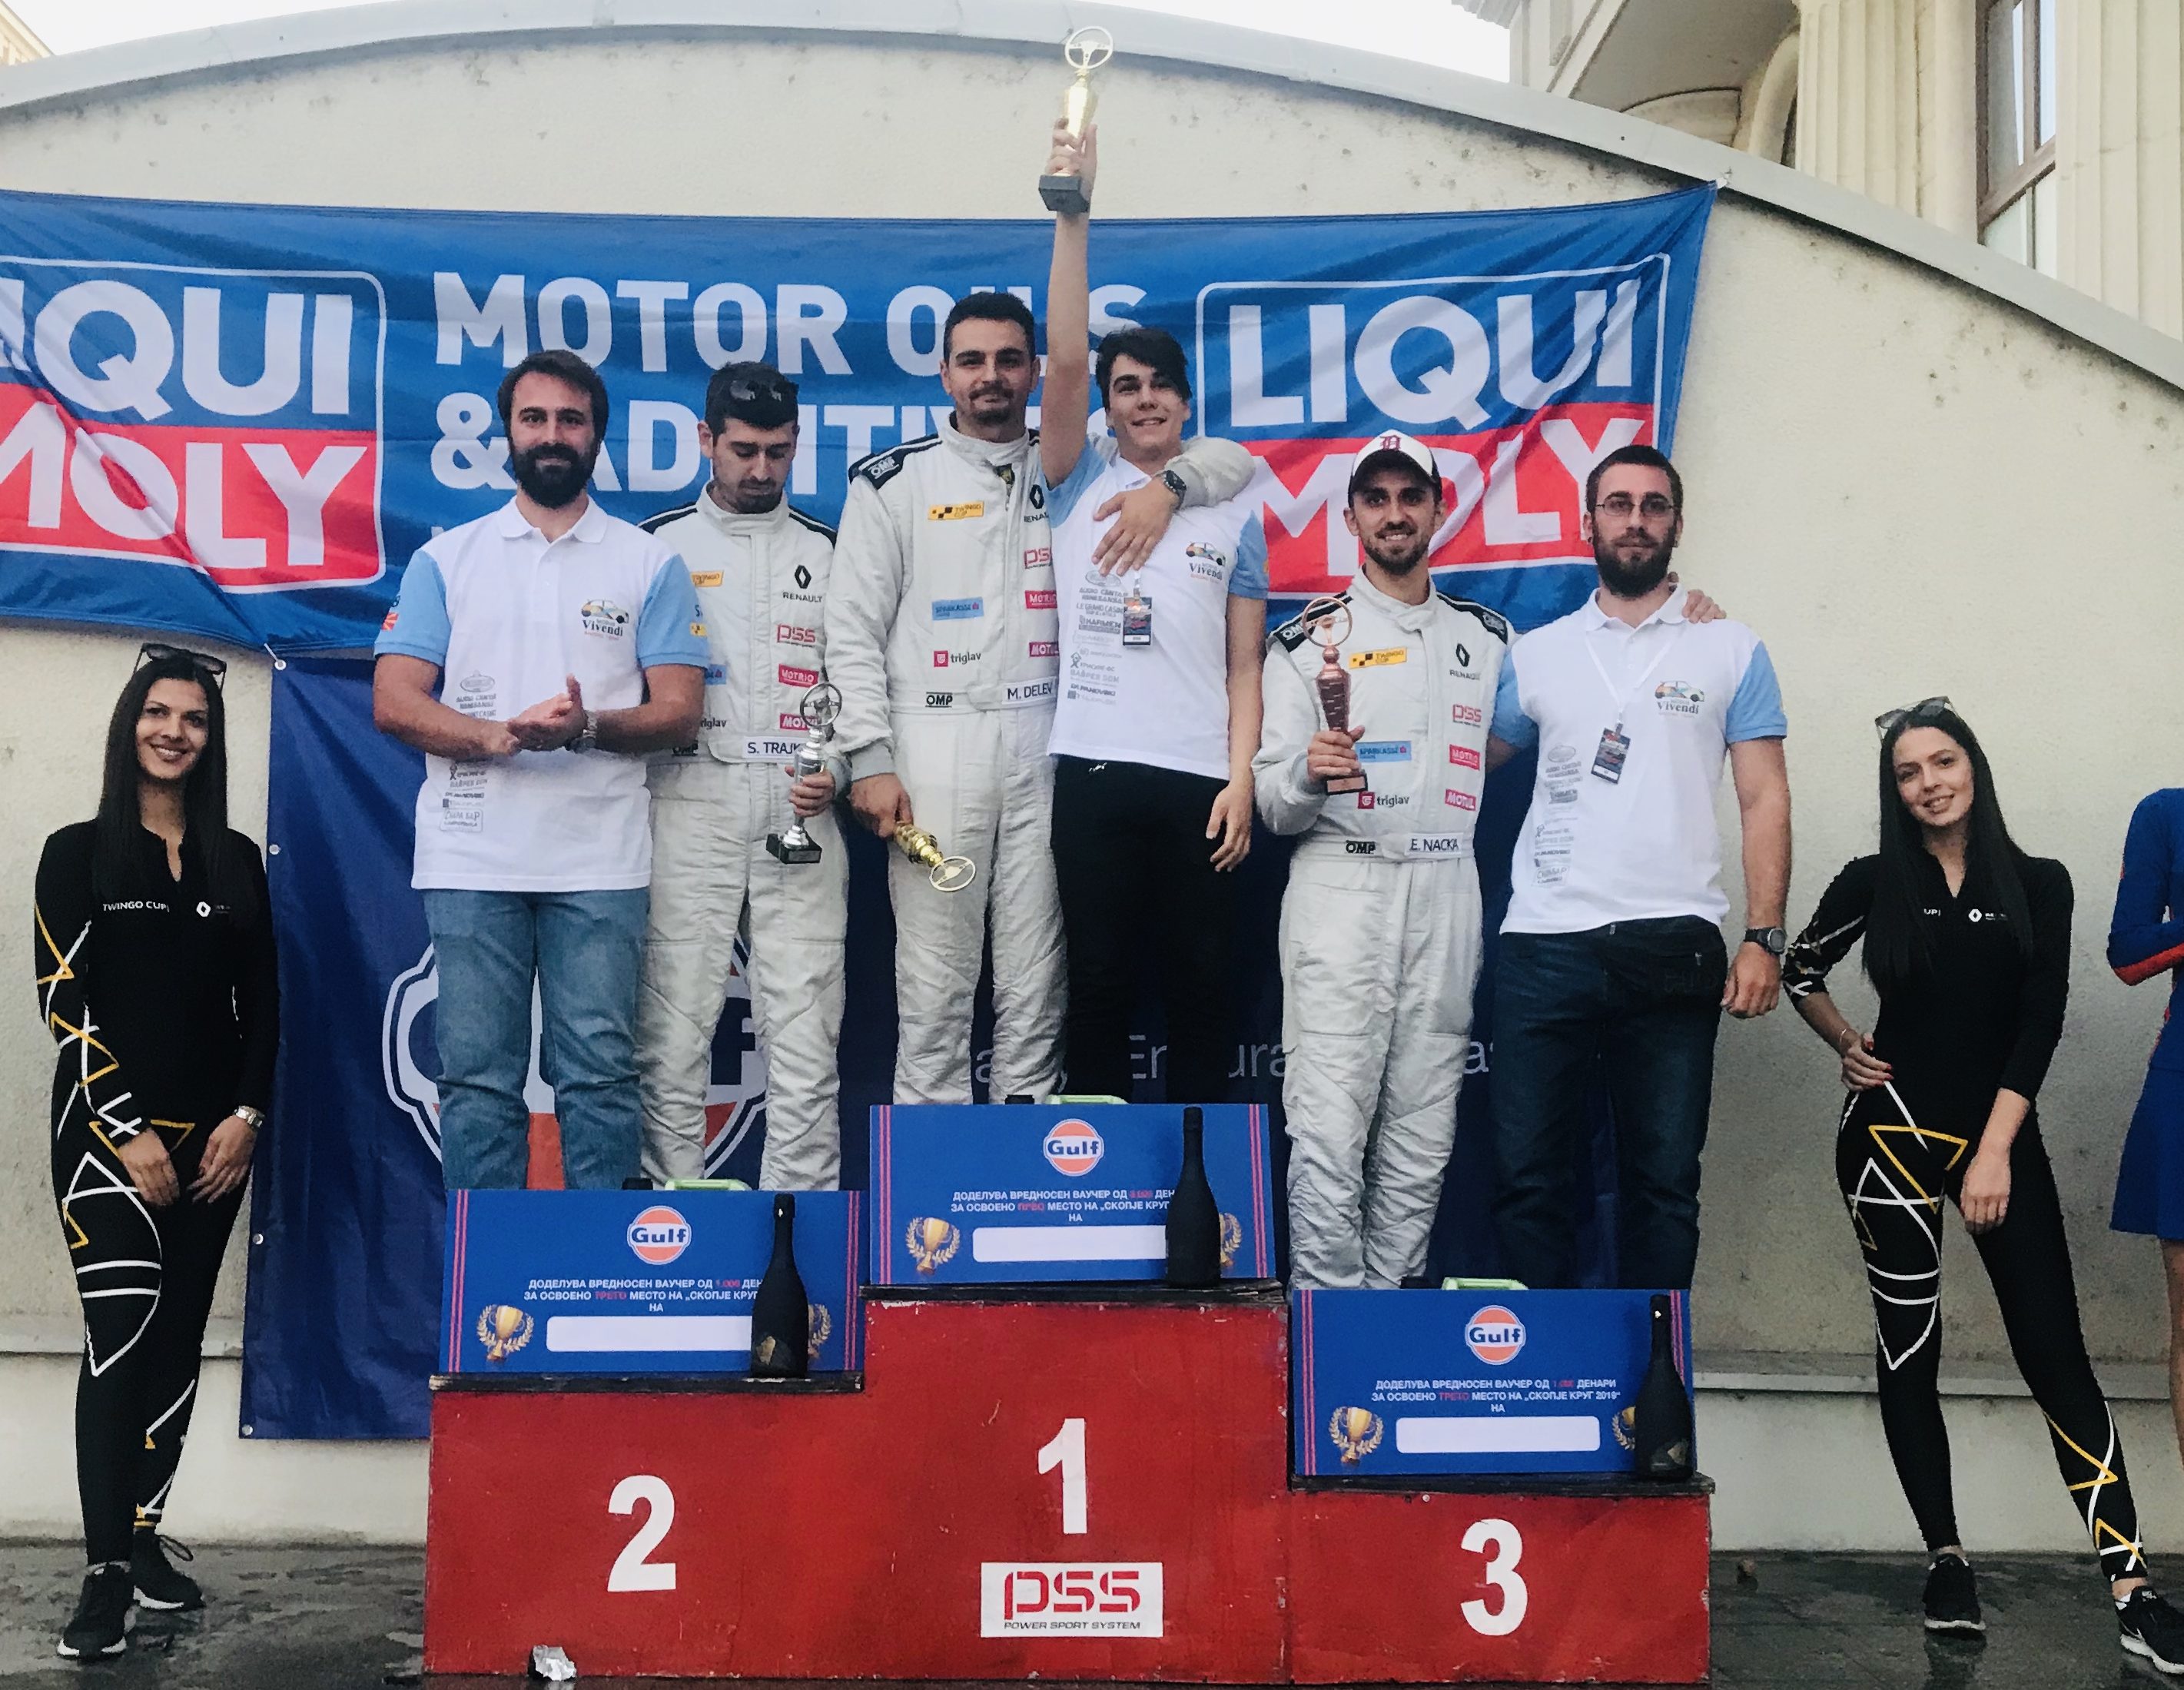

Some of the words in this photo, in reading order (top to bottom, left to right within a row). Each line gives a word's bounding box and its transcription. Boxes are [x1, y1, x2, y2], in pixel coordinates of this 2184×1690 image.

[433, 271, 853, 376] MOTOR
[0, 277, 353, 421] IQUI
[1229, 278, 1641, 430] LIQUI
[782, 591, 823, 603] RENAULT
[582, 619, 623, 636] Vivendi
[777, 623, 816, 643] PSS
[1282, 622, 1304, 638] OM
[951, 651, 982, 665] triglav
[781, 669, 815, 681] MOTRIO
[926, 692, 953, 706] OMP
[1007, 687, 1022, 700] M.
[1452, 704, 1482, 722] PSS
[1657, 701, 1700, 715] Vivendi
[700, 717, 727, 730] riglav
[748, 742, 760, 754] S.
[1376, 794, 1410, 808] triglav
[1346, 842, 1376, 854] OMP
[102, 901, 144, 911] TWINGO
[146, 901, 167, 910] CUP
[1047, 1140, 1100, 1155] Gulf
[952, 1191, 1007, 1201] ДОДЕЛУВА
[1010, 1190, 1070, 1201] ВРЕДНОСЕН
[1073, 1190, 1110, 1200] ВАУЧЕР
[1113, 1190, 1128, 1200] ОД
[951, 1203, 964, 1212] ЗА
[966, 1203, 1016, 1212] ОСВОЕНО
[1047, 1202, 1082, 1211] МЕСТО
[1084, 1201, 1098, 1210] НА
[1068, 1214, 1083, 1222] НА
[631, 1227, 687, 1243] Gulf
[528, 1280, 586, 1290] ДОДЕЛУВА
[589, 1279, 652, 1290] ВРЕДНОСЕН
[655, 1279, 695, 1288] ВАУЧЕР
[698, 1279, 713, 1290] ОД
[523, 1291, 538, 1300] ЗА
[540, 1291, 591, 1300] ОСВОЕНО
[629, 1291, 665, 1300] МЕСТО
[669, 1291, 683, 1300] НА
[649, 1303, 663, 1312] НА
[1469, 1326, 1521, 1343] Gulf
[1375, 1380, 1430, 1390] ДОДЕЛУВА
[1432, 1380, 1493, 1390] ВРЕДНОСЕН
[1495, 1379, 1532, 1389] ВАУЧЕР
[1535, 1379, 1550, 1390] ОД
[1576, 1379, 1616, 1390] ДЕНАРИ
[1372, 1392, 1386, 1401] ЗА
[1387, 1392, 1436, 1401] ОСВОЕНО
[1472, 1392, 1506, 1400] МЕСТО
[1509, 1392, 1522, 1400] НА
[1569, 1391, 1594, 1399] КРУГ
[1491, 1403, 1505, 1413] НА
[1037, 1417, 1088, 1536] 1
[606, 1474, 677, 1592] 2
[1460, 1518, 1528, 1636] 3
[1004, 1571, 1140, 1620] PSS
